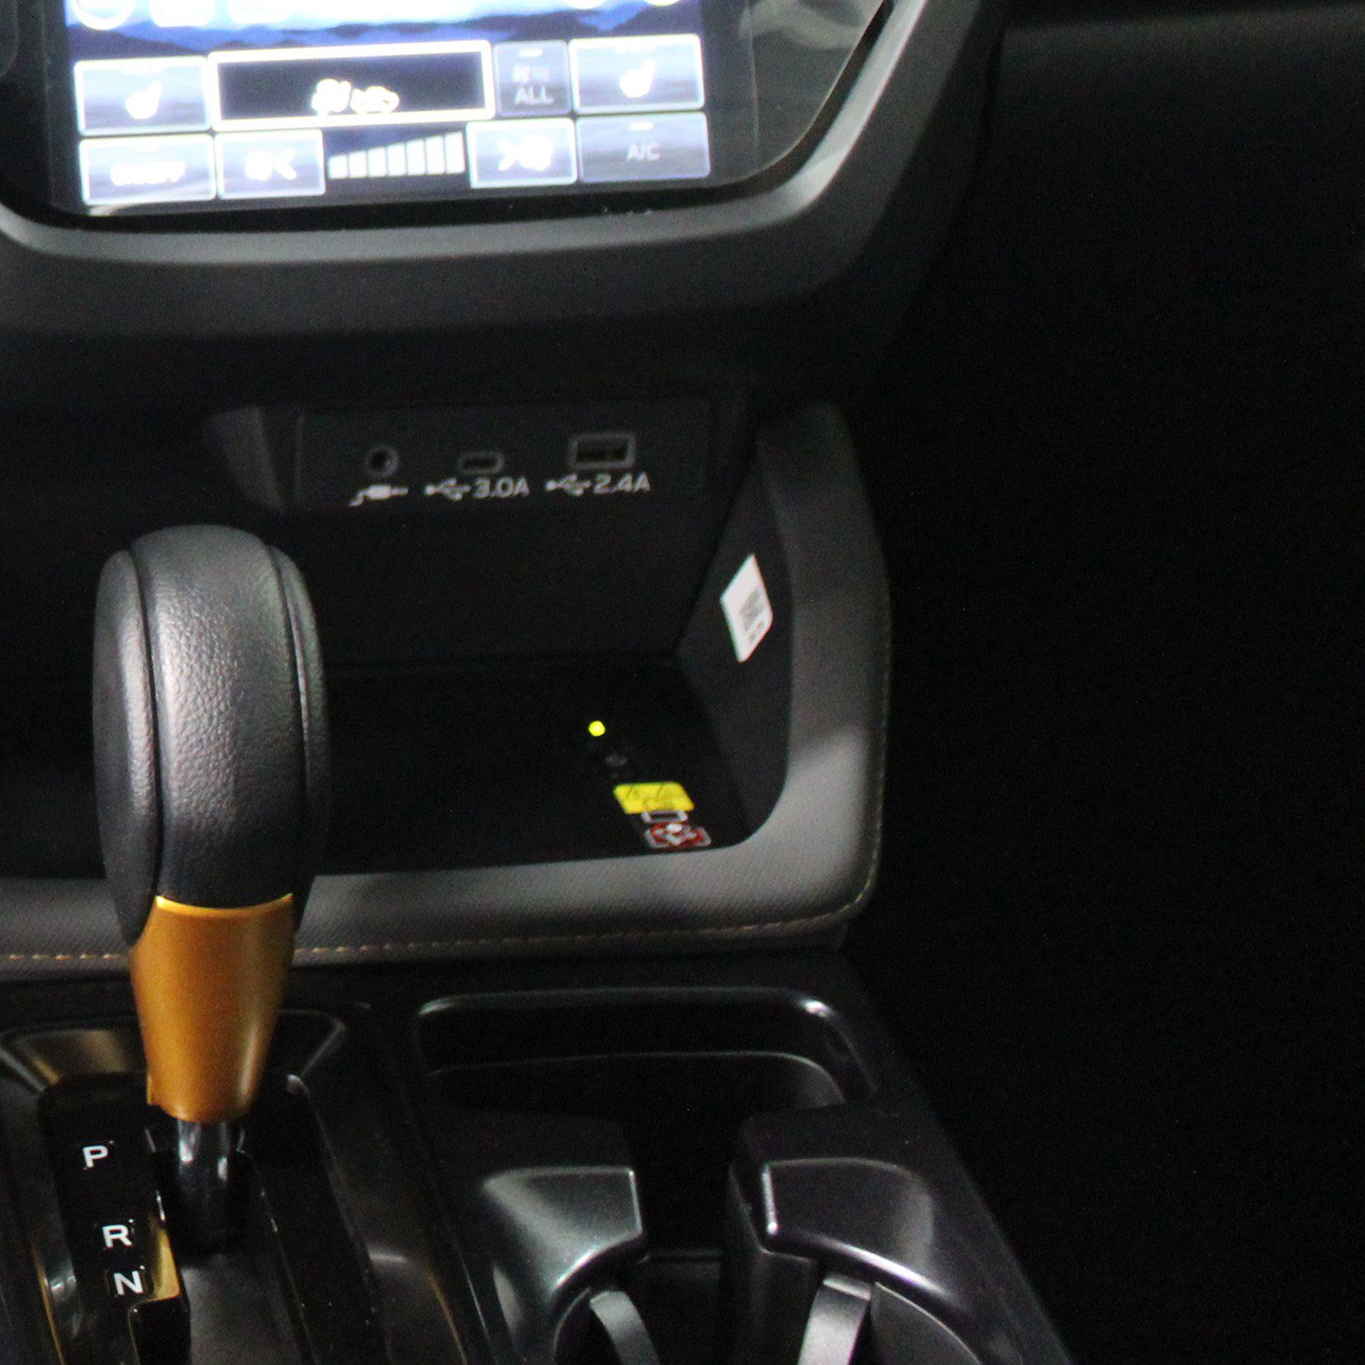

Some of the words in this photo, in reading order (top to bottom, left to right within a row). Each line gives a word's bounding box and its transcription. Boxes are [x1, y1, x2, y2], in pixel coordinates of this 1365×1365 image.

[514, 85, 554, 105] ALL
[627, 142, 661, 161] A/C
[473, 476, 530, 498] 3.0A
[593, 472, 651, 495] 2.4A
[82, 1144, 109, 1168] P
[102, 1224, 133, 1248] R
[113, 1270, 144, 1295] N
